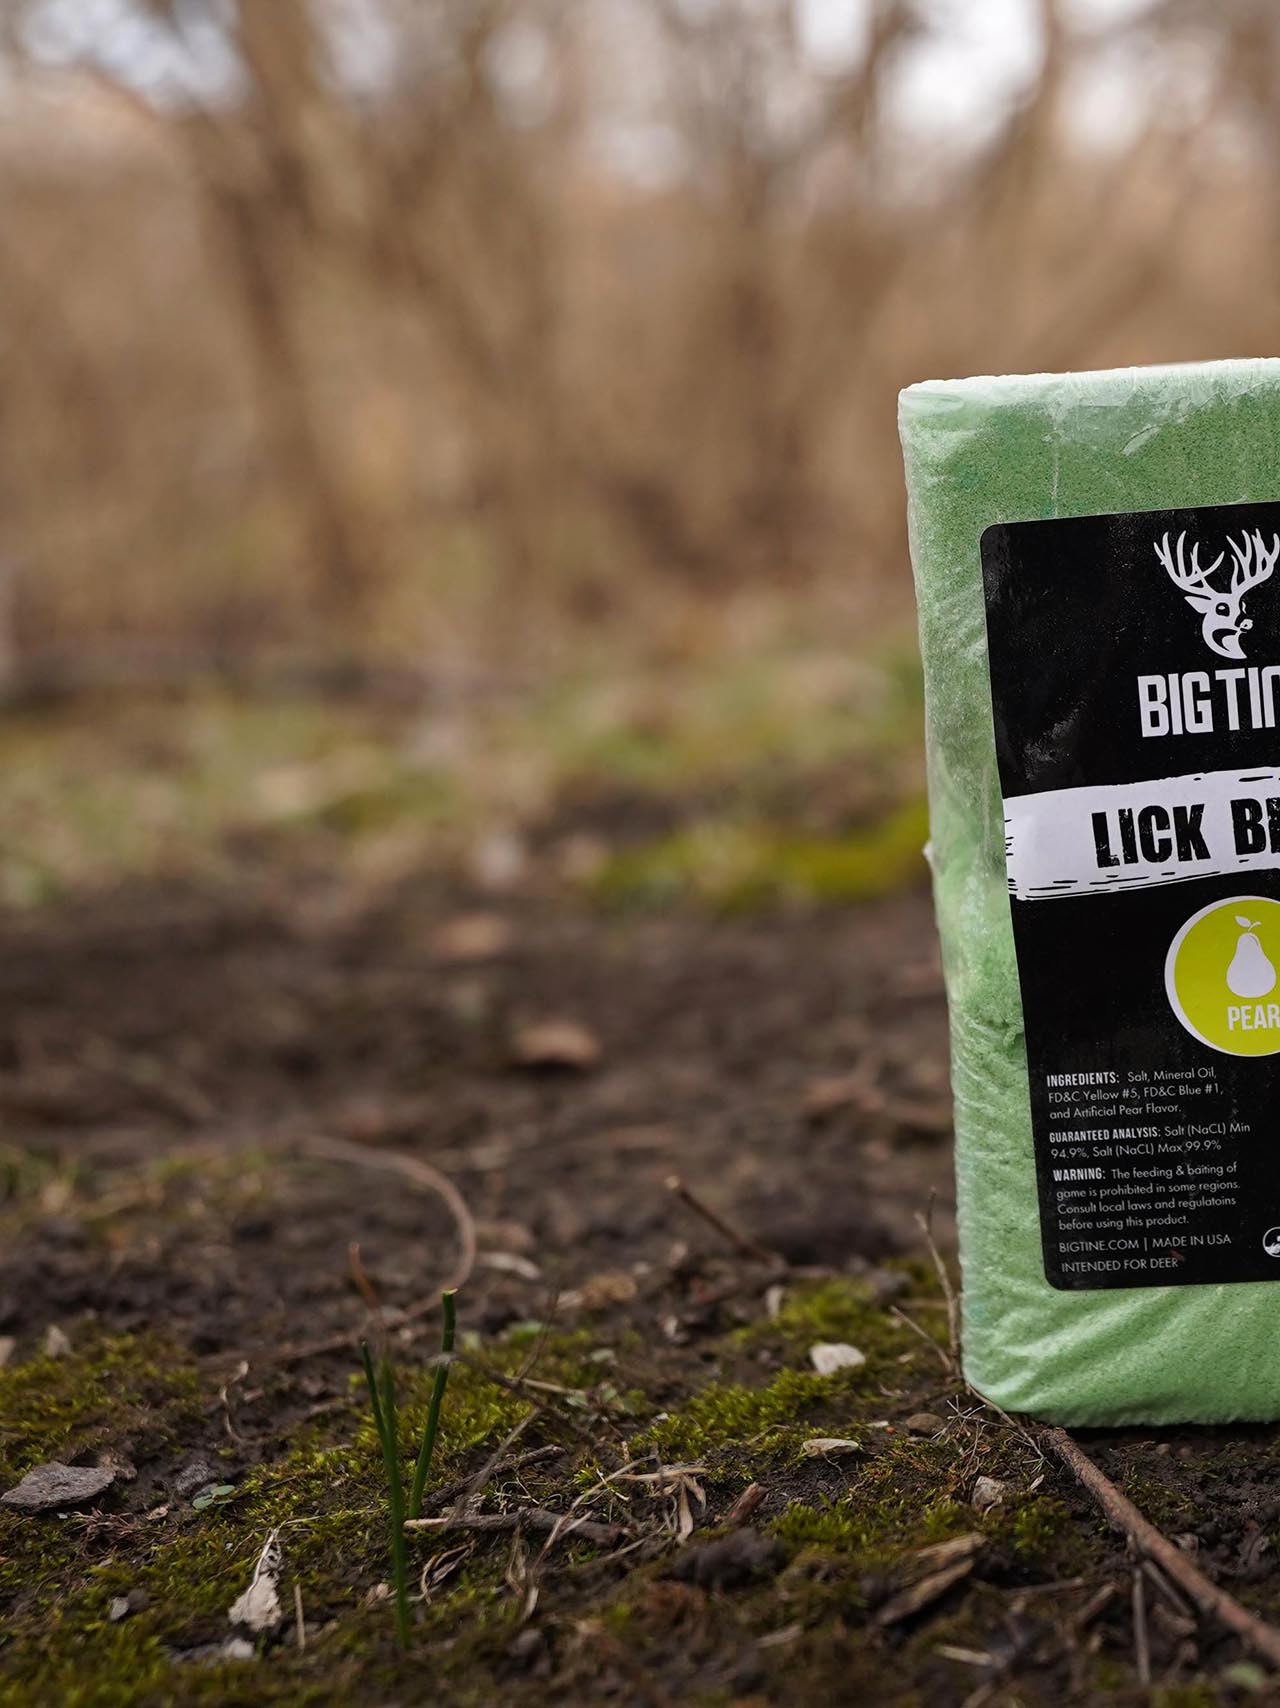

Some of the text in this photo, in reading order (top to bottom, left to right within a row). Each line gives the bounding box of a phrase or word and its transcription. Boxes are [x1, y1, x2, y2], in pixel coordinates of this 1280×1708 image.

[1092, 803, 1211, 868] LICK
[1227, 1004, 1280, 1031] PEAR
[1047, 1066, 1217, 1087] INGREDIENTS: Salt, Mineral Oil,
[1048, 1091, 1080, 1103] FD&C
[1083, 1089, 1119, 1101] Yellow
[1143, 1085, 1176, 1097] FD&C
[1179, 1084, 1202, 1096] Blue
[1049, 1102, 1182, 1120] and Artificial Pear Flavor.
[1049, 1122, 1250, 1143] GUARANTEED ANALYSIS: Salt (NaCL) Min
[1051, 1139, 1222, 1159] 94.9%, Salt (NaCL) Max 99.9%
[1053, 1161, 1237, 1181] WARNING: The feeding & baiting of
[1056, 1180, 1241, 1201] game is prohibited in some regions.
[1057, 1202, 1097, 1214] Consult
[1099, 1200, 1125, 1212] local
[1127, 1200, 1152, 1210] laws
[1154, 1197, 1176, 1210] and
[1059, 1213, 1190, 1230] before using this product.
[1059, 1239, 1140, 1253] BIGTINE.COM
[1152, 1236, 1187, 1248] MADE
[1190, 1235, 1204, 1246] IN
[1207, 1234, 1232, 1245] USA
[1061, 1258, 1178, 1273] INTENDED FOR DEER
